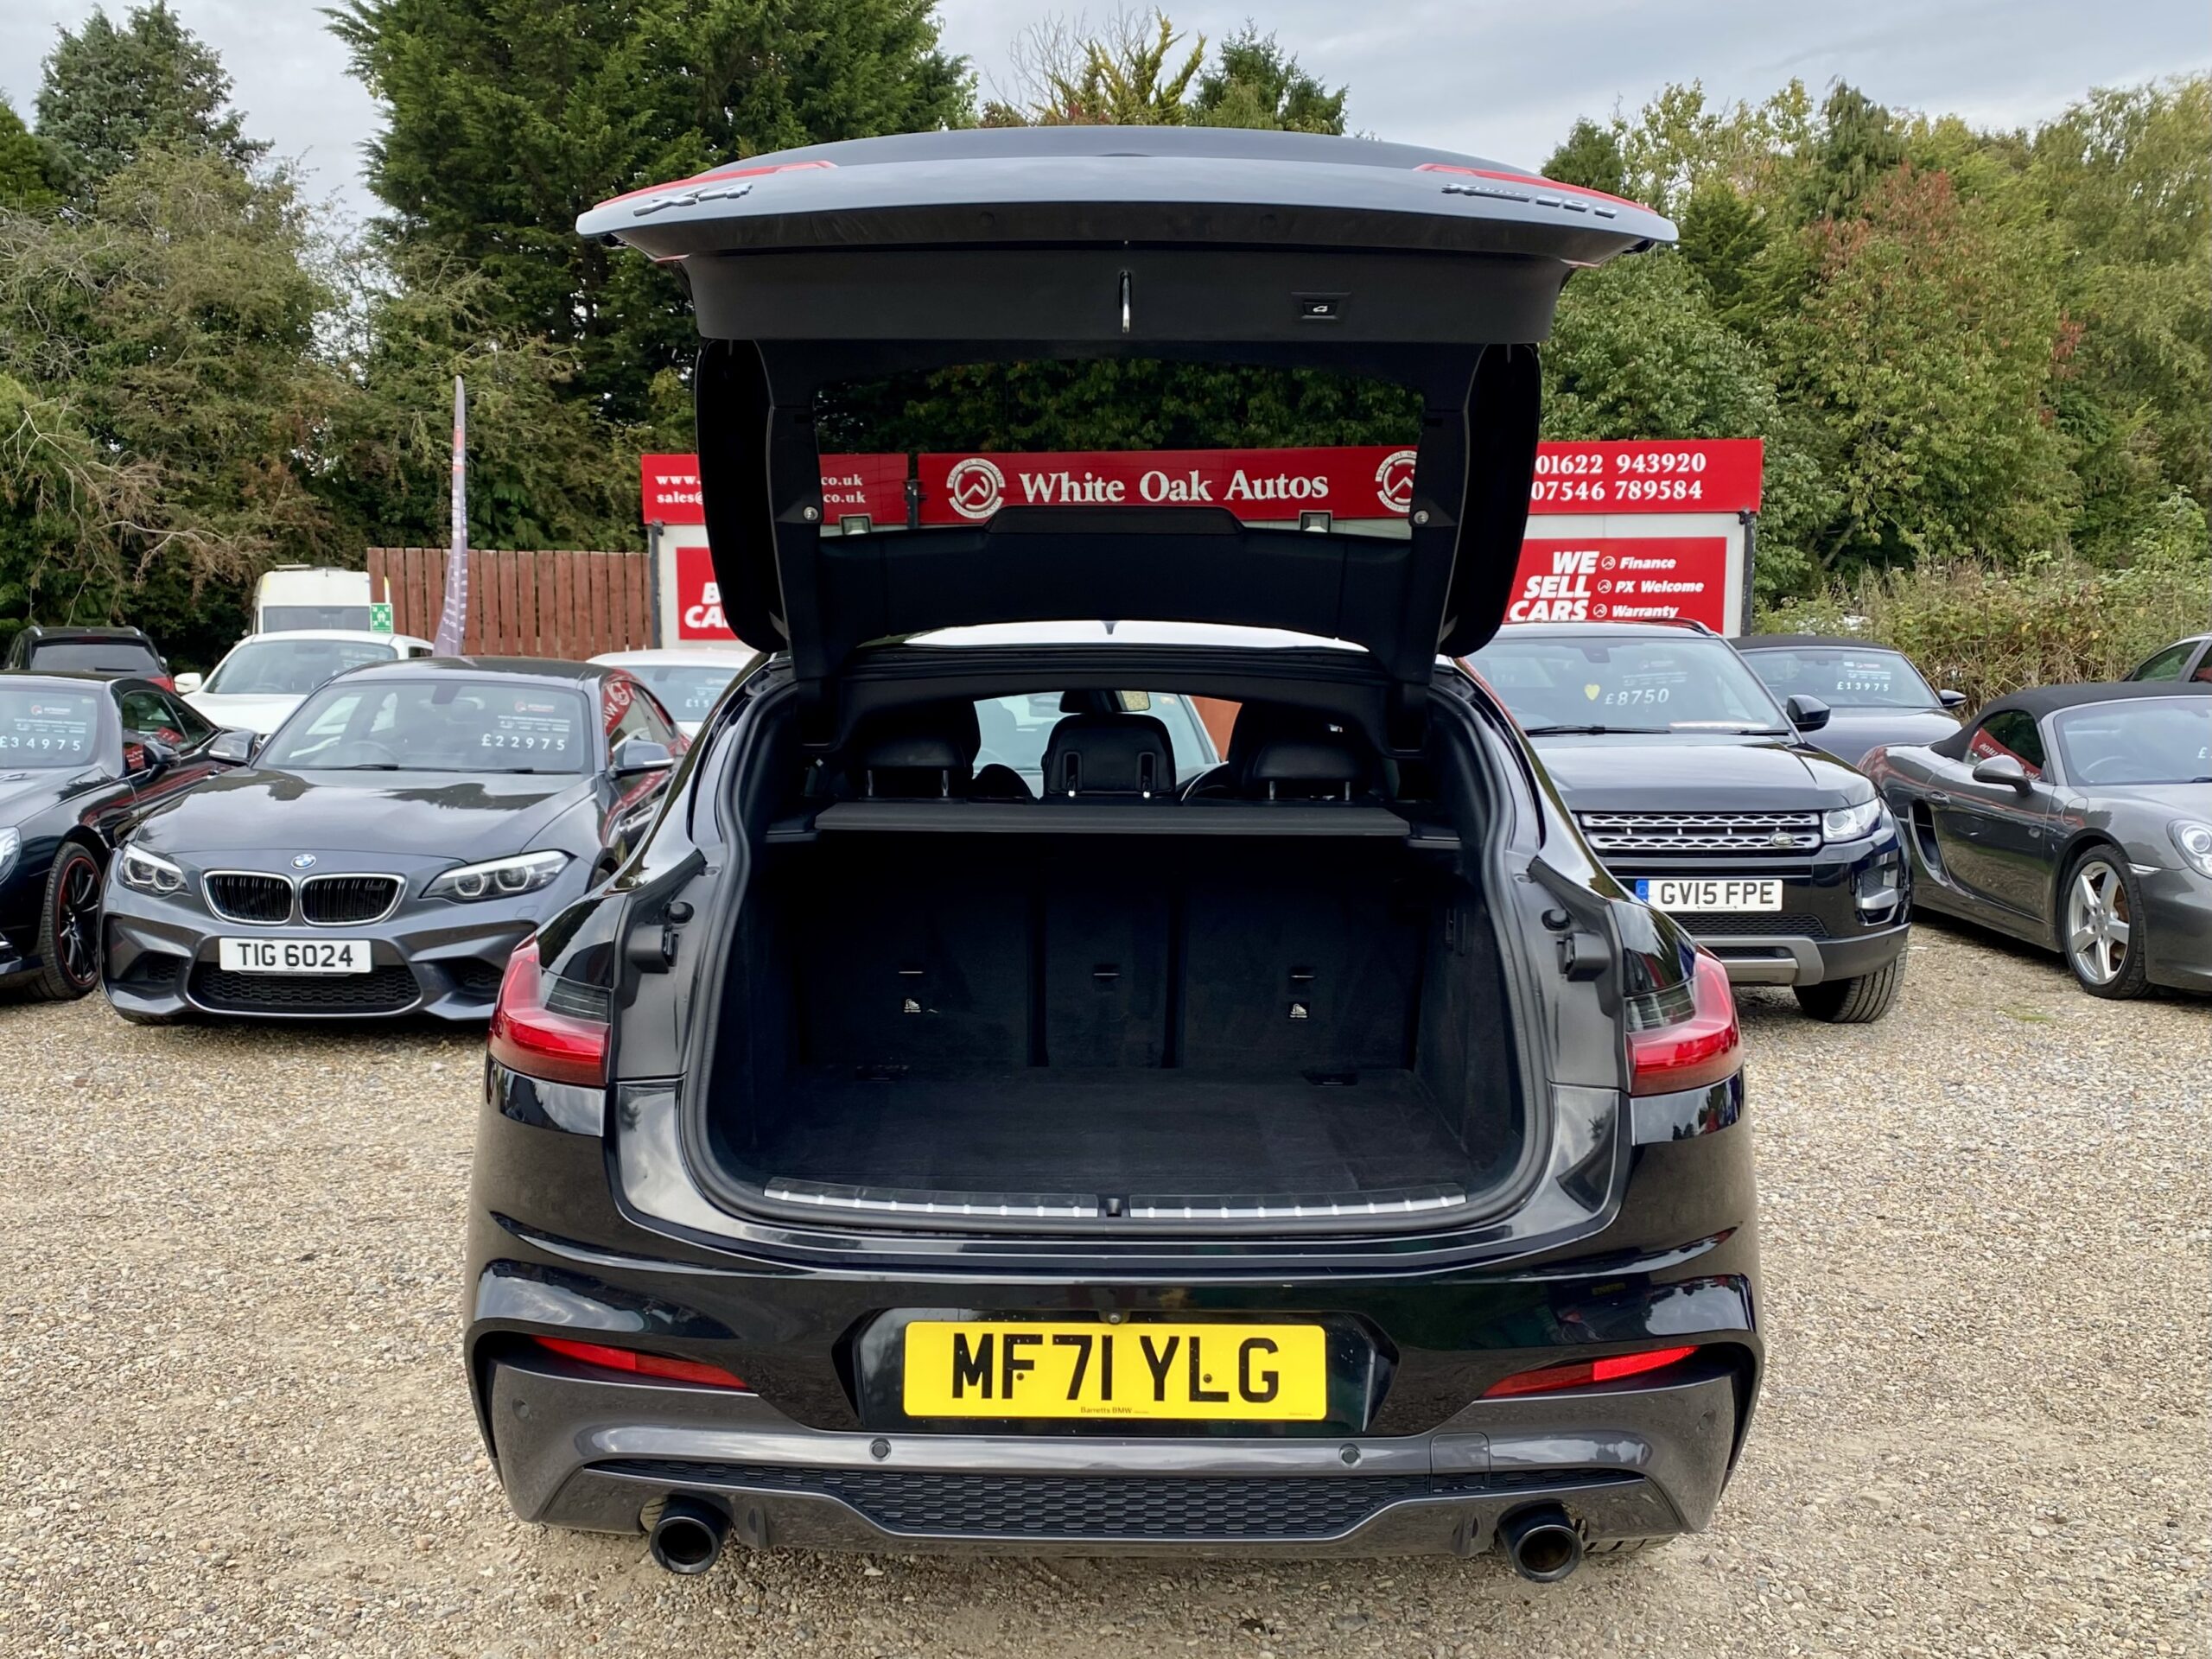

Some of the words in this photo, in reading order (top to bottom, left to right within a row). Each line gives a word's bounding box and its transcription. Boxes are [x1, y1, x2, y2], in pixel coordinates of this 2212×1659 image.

[1535, 454, 1603, 474] 01622
[1616, 453, 1707, 474] 943920
[1019, 471, 1126, 503] White
[1139, 470, 1213, 502] Oak
[1224, 469, 1329, 500] Autos
[1531, 480, 1605, 500] 07546
[1615, 480, 1703, 499] 789584
[1552, 551, 1600, 574] WE
[1619, 556, 1677, 569] Finance
[1523, 575, 1592, 598] SELL
[1615, 581, 1636, 593] PX
[1641, 581, 1704, 593] Welcome
[1510, 600, 1589, 621] CARS
[1612, 605, 1679, 619] Warranty
[1837, 681, 1889, 692] £13975
[1605, 688, 1669, 706] £8750
[0, 735, 81, 752] £34975
[481, 733, 566, 751] £22975
[1661, 882, 1718, 905] GV15
[1726, 881, 1775, 905] FPE
[237, 943, 276, 966] TIG
[284, 944, 353, 968] 6024
[952, 1332, 1113, 1401] MF71
[1140, 1335, 1280, 1403] YLG
